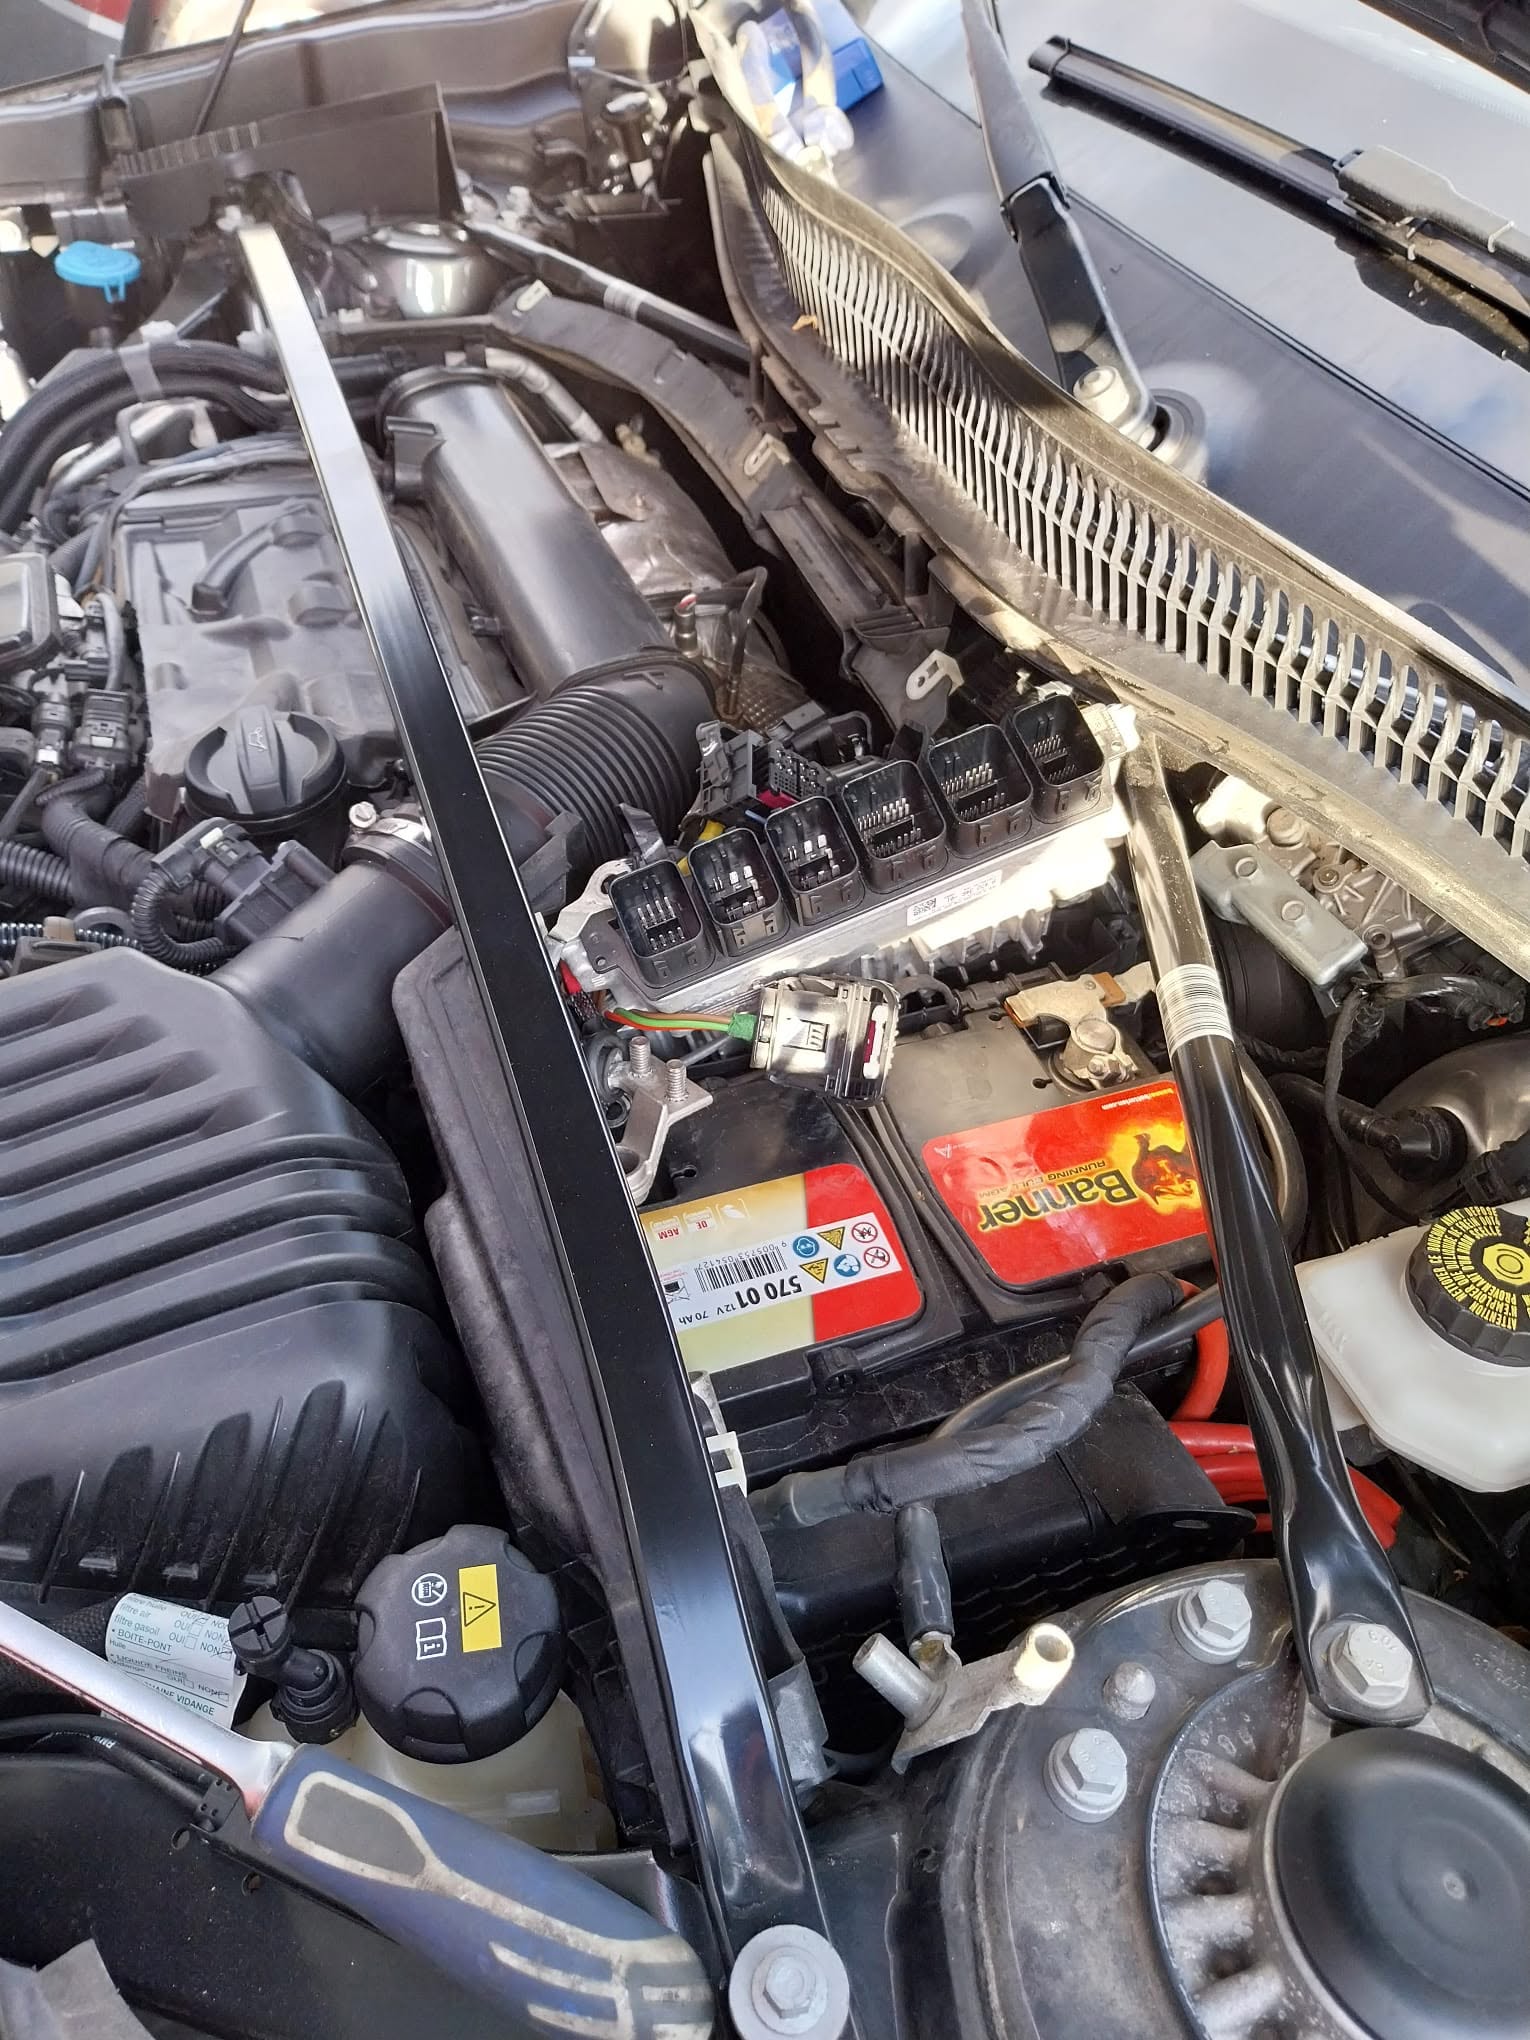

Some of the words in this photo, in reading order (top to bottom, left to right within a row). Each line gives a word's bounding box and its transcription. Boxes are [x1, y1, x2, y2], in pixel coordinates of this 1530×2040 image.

[1046, 1160, 1106, 1182] RUNNING
[979, 1168, 1138, 1231] Banner
[658, 1227, 680, 1240] AGM
[1427, 1254, 1442, 1264] CE
[763, 1275, 802, 1300] 570
[1432, 1266, 1467, 1302] NETTOYER
[1450, 1270, 1470, 1286] QUE
[1466, 1272, 1517, 1306] PROVENANT
[735, 1287, 761, 1309] 01
[679, 1314, 693, 1325] Ah
[695, 1311, 709, 1321] 70
[1468, 1301, 1518, 1331] ATTENTION
[176, 1694, 215, 1716] VIDANGE
